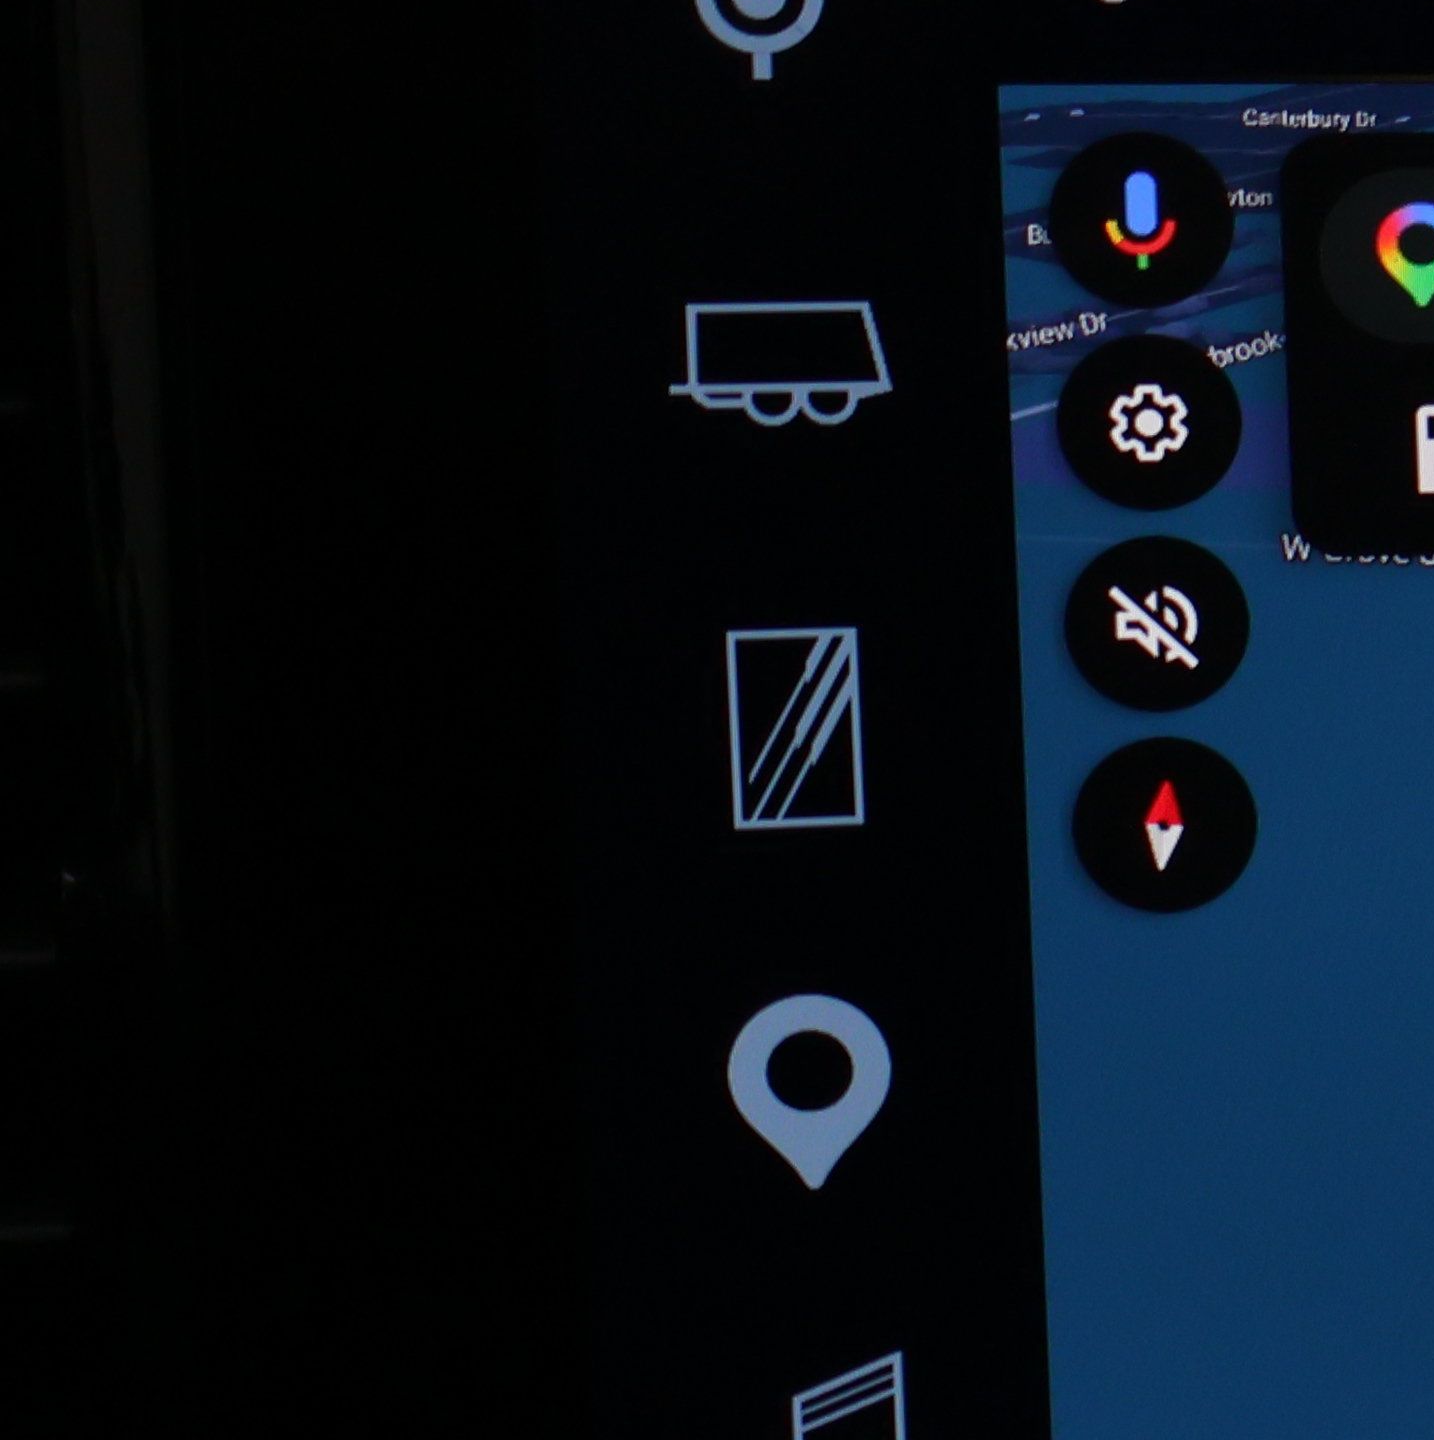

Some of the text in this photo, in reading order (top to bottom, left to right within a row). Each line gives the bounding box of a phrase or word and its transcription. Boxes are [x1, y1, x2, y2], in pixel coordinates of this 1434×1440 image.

[1242, 108, 1377, 131] Canterbury Dr
[1078, 311, 1108, 335] Dr
